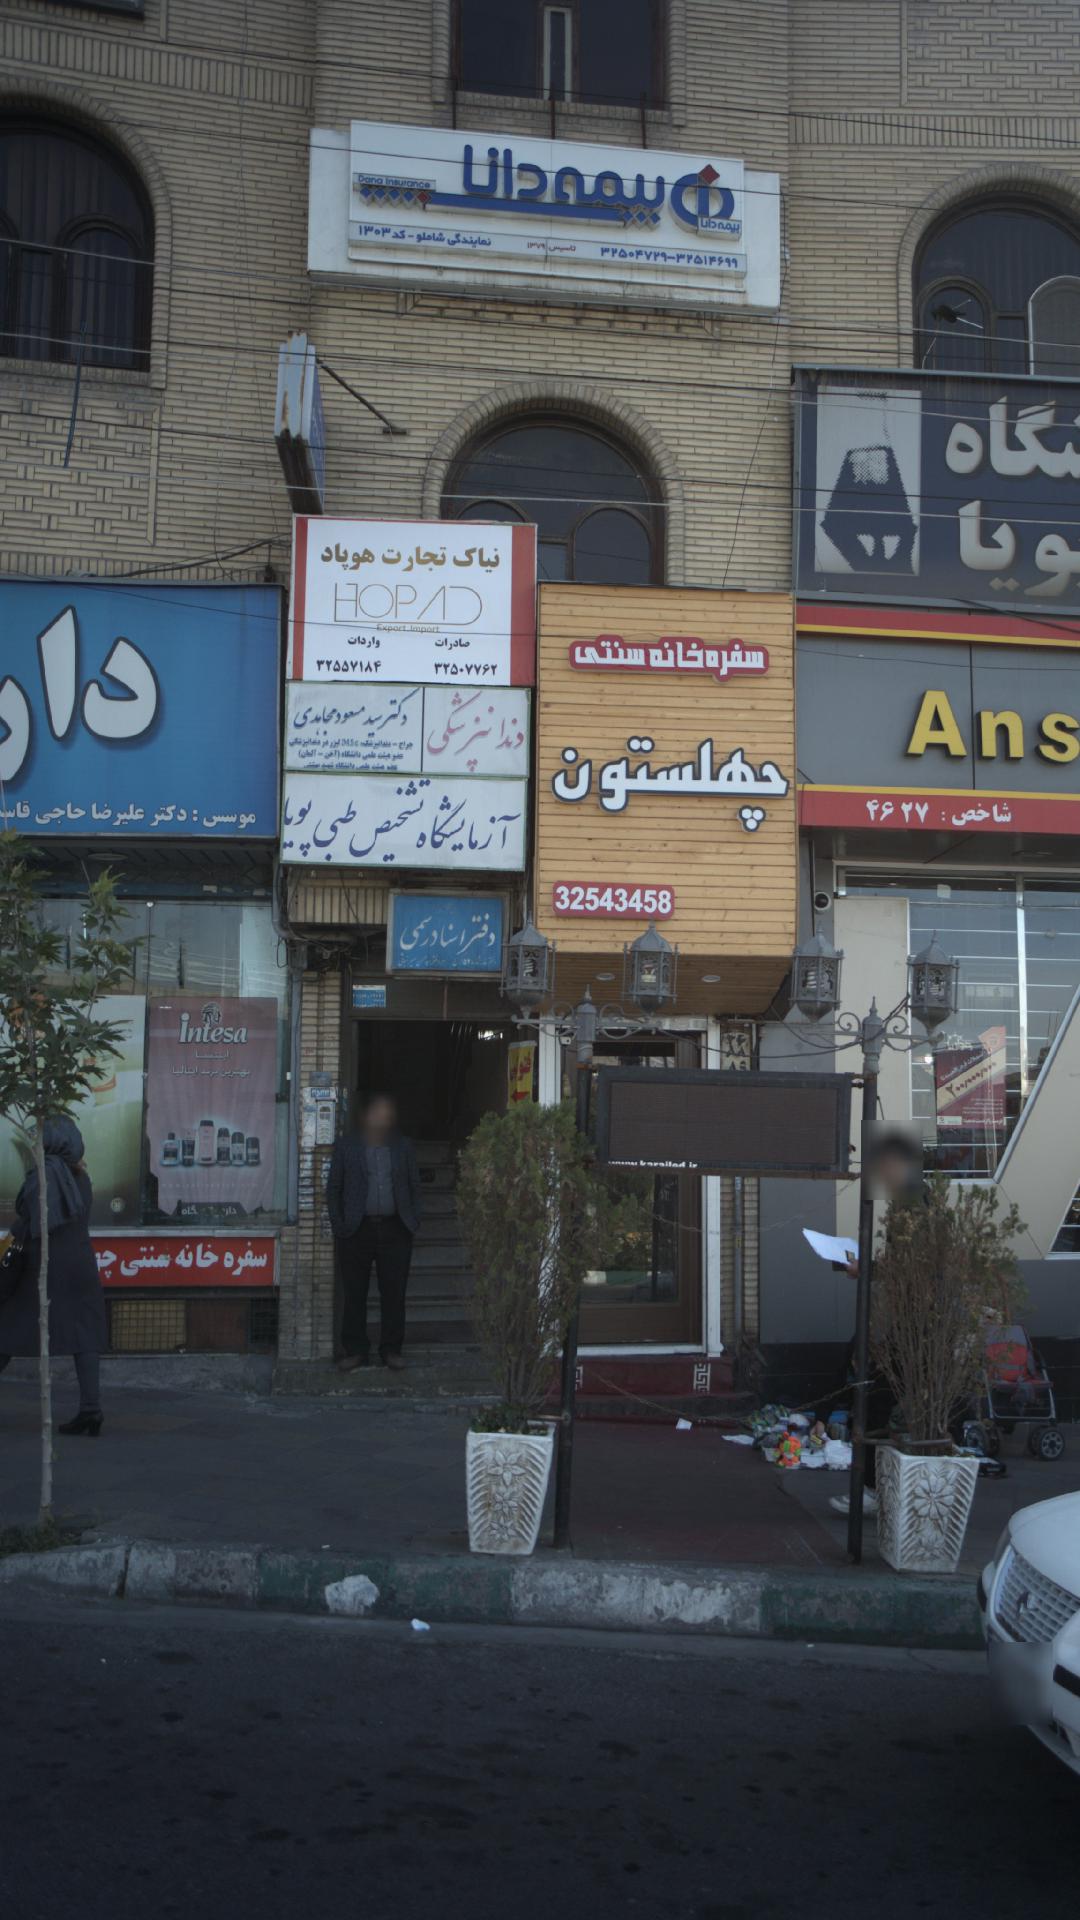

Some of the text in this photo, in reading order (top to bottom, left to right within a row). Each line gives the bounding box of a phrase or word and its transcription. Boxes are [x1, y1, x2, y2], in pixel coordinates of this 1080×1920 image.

[358, 174, 431, 189] Dana Insurance
[462, 144, 548, 199] دانا
[358, 224, 391, 236] ۱۳۰۳
[391, 229, 406, 239] کد
[416, 231, 446, 243] شاملو
[447, 233, 492, 248] نمایندگی
[320, 543, 501, 573] نیاک تجارت هوپاد
[334, 583, 483, 625] HOPAD
[347, 635, 381, 649] واردات
[434, 636, 471, 650] صادرات
[316, 658, 382, 674] ۳۲۵۵۷۱۸۴
[434, 662, 498, 677] ۳۲۵۰۷۷۶۲
[574, 640, 765, 676] سفره خانه سنتی
[376, 687, 421, 730] دکتر
[551, 735, 790, 833] چهلستون
[35, 801, 87, 825] حاجی
[91, 801, 145, 826] علیرضا
[150, 804, 188, 826] دکتر
[202, 810, 256, 829] موسس
[282, 779, 522, 862] آزمایشگاه تشخیص طبی پویا
[951, 801, 1013, 827] شاخص
[555, 885, 672, 914] 32543458
[399, 912, 496, 955] دفتر اسناد رسمی
[119, 1245, 171, 1276] سنتی
[175, 1242, 219, 1268] خانه
[223, 1241, 268, 1276] سفره
